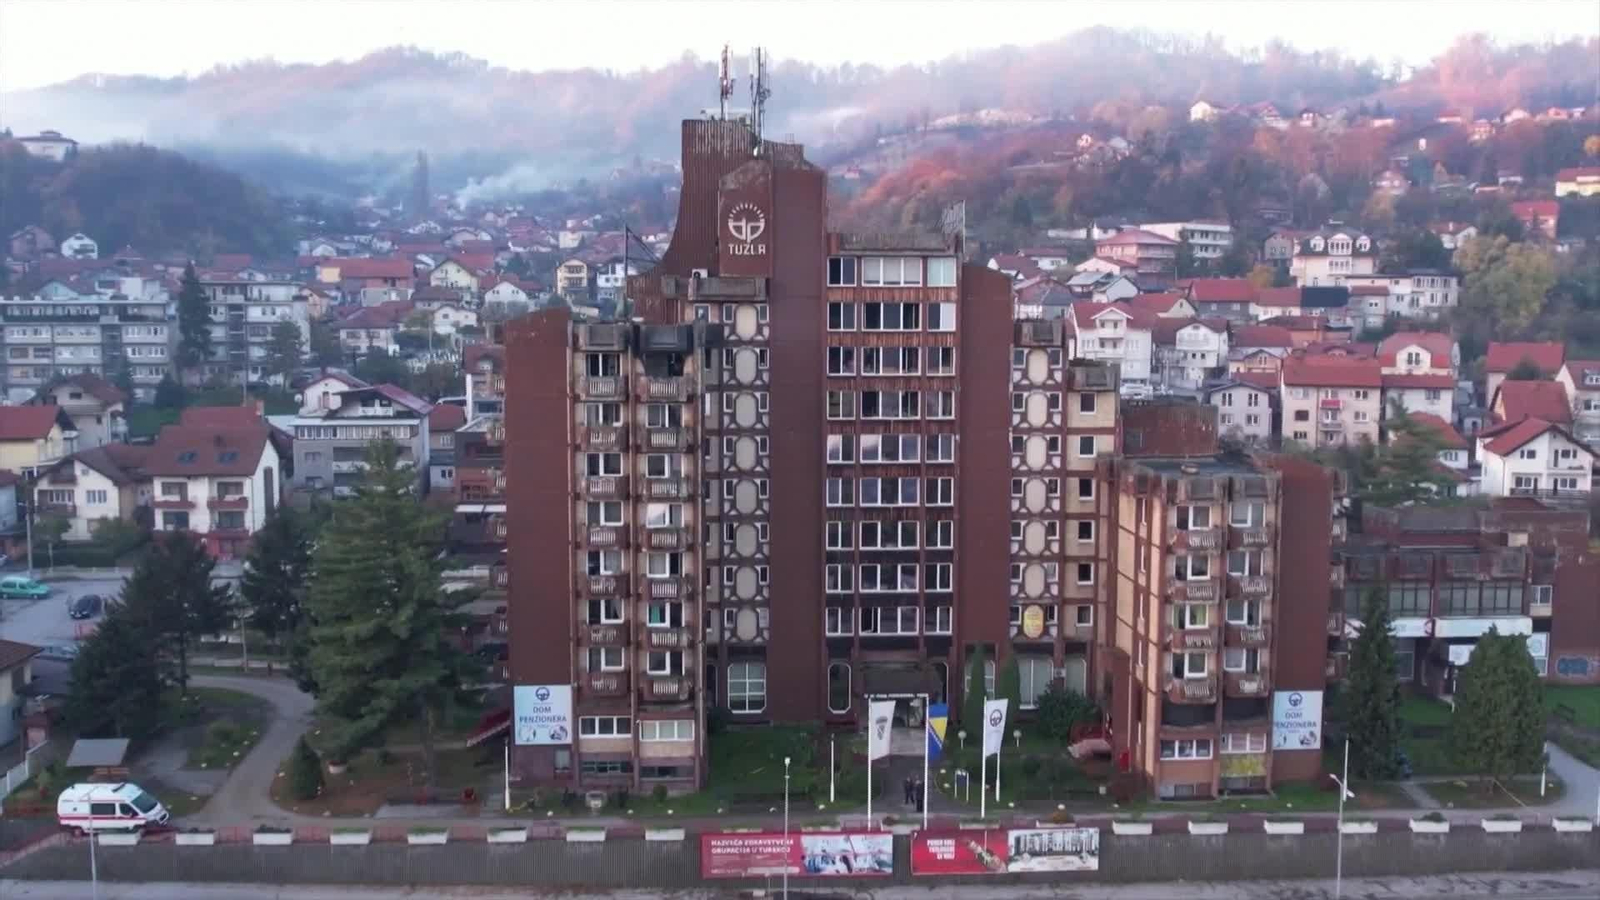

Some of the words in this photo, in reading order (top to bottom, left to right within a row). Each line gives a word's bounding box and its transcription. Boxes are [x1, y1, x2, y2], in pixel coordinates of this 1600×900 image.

[728, 243, 766, 256] TUZLA
[533, 706, 552, 714] DOM
[1285, 711, 1303, 719] DOM
[519, 715, 567, 724] PENZIONERA
[711, 846, 751, 854] GRUPACIJA
[752, 846, 758, 854] U
